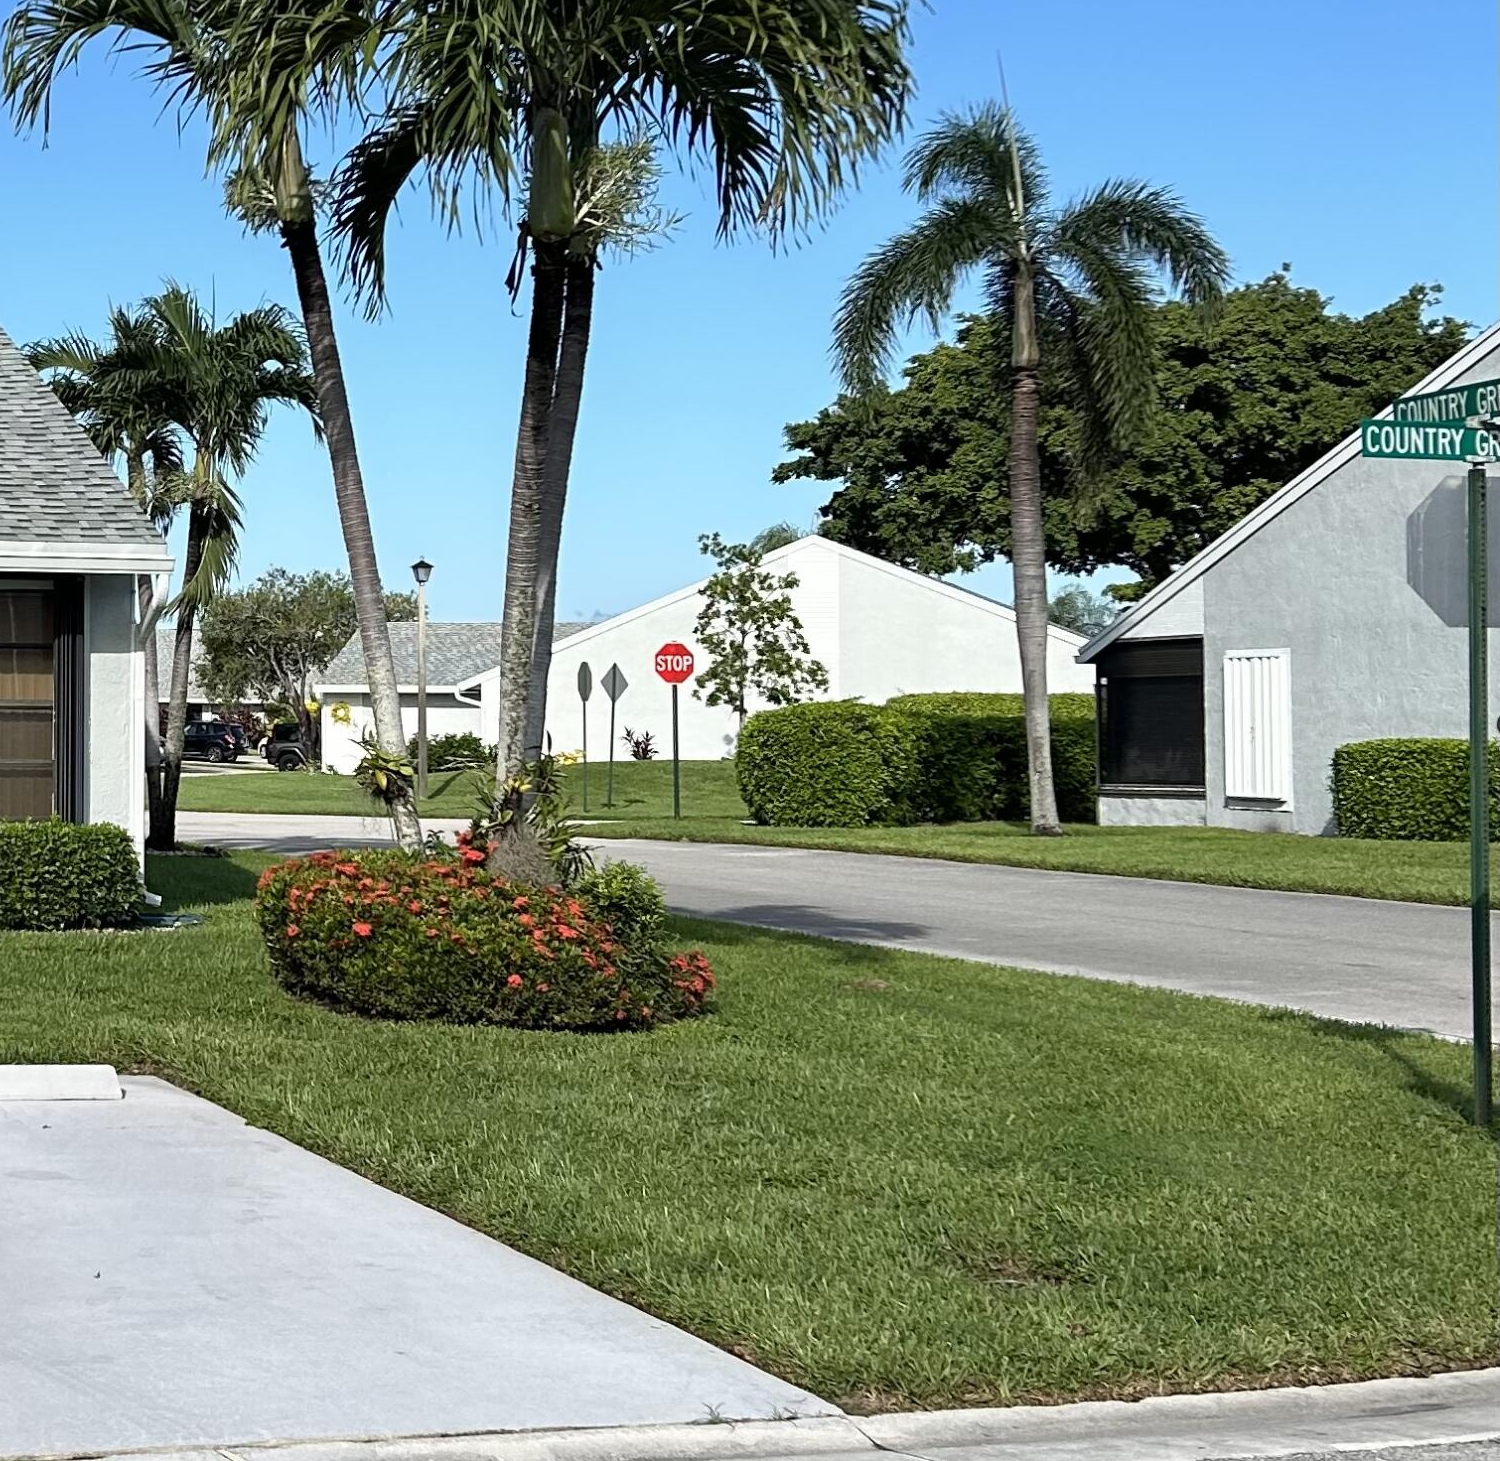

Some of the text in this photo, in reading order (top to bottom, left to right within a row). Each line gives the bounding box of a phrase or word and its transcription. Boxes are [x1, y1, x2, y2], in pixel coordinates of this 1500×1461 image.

[1397, 391, 1468, 422] COUNTRY
[1366, 425, 1465, 455] COUNTRY
[656, 655, 693, 672] STOP
